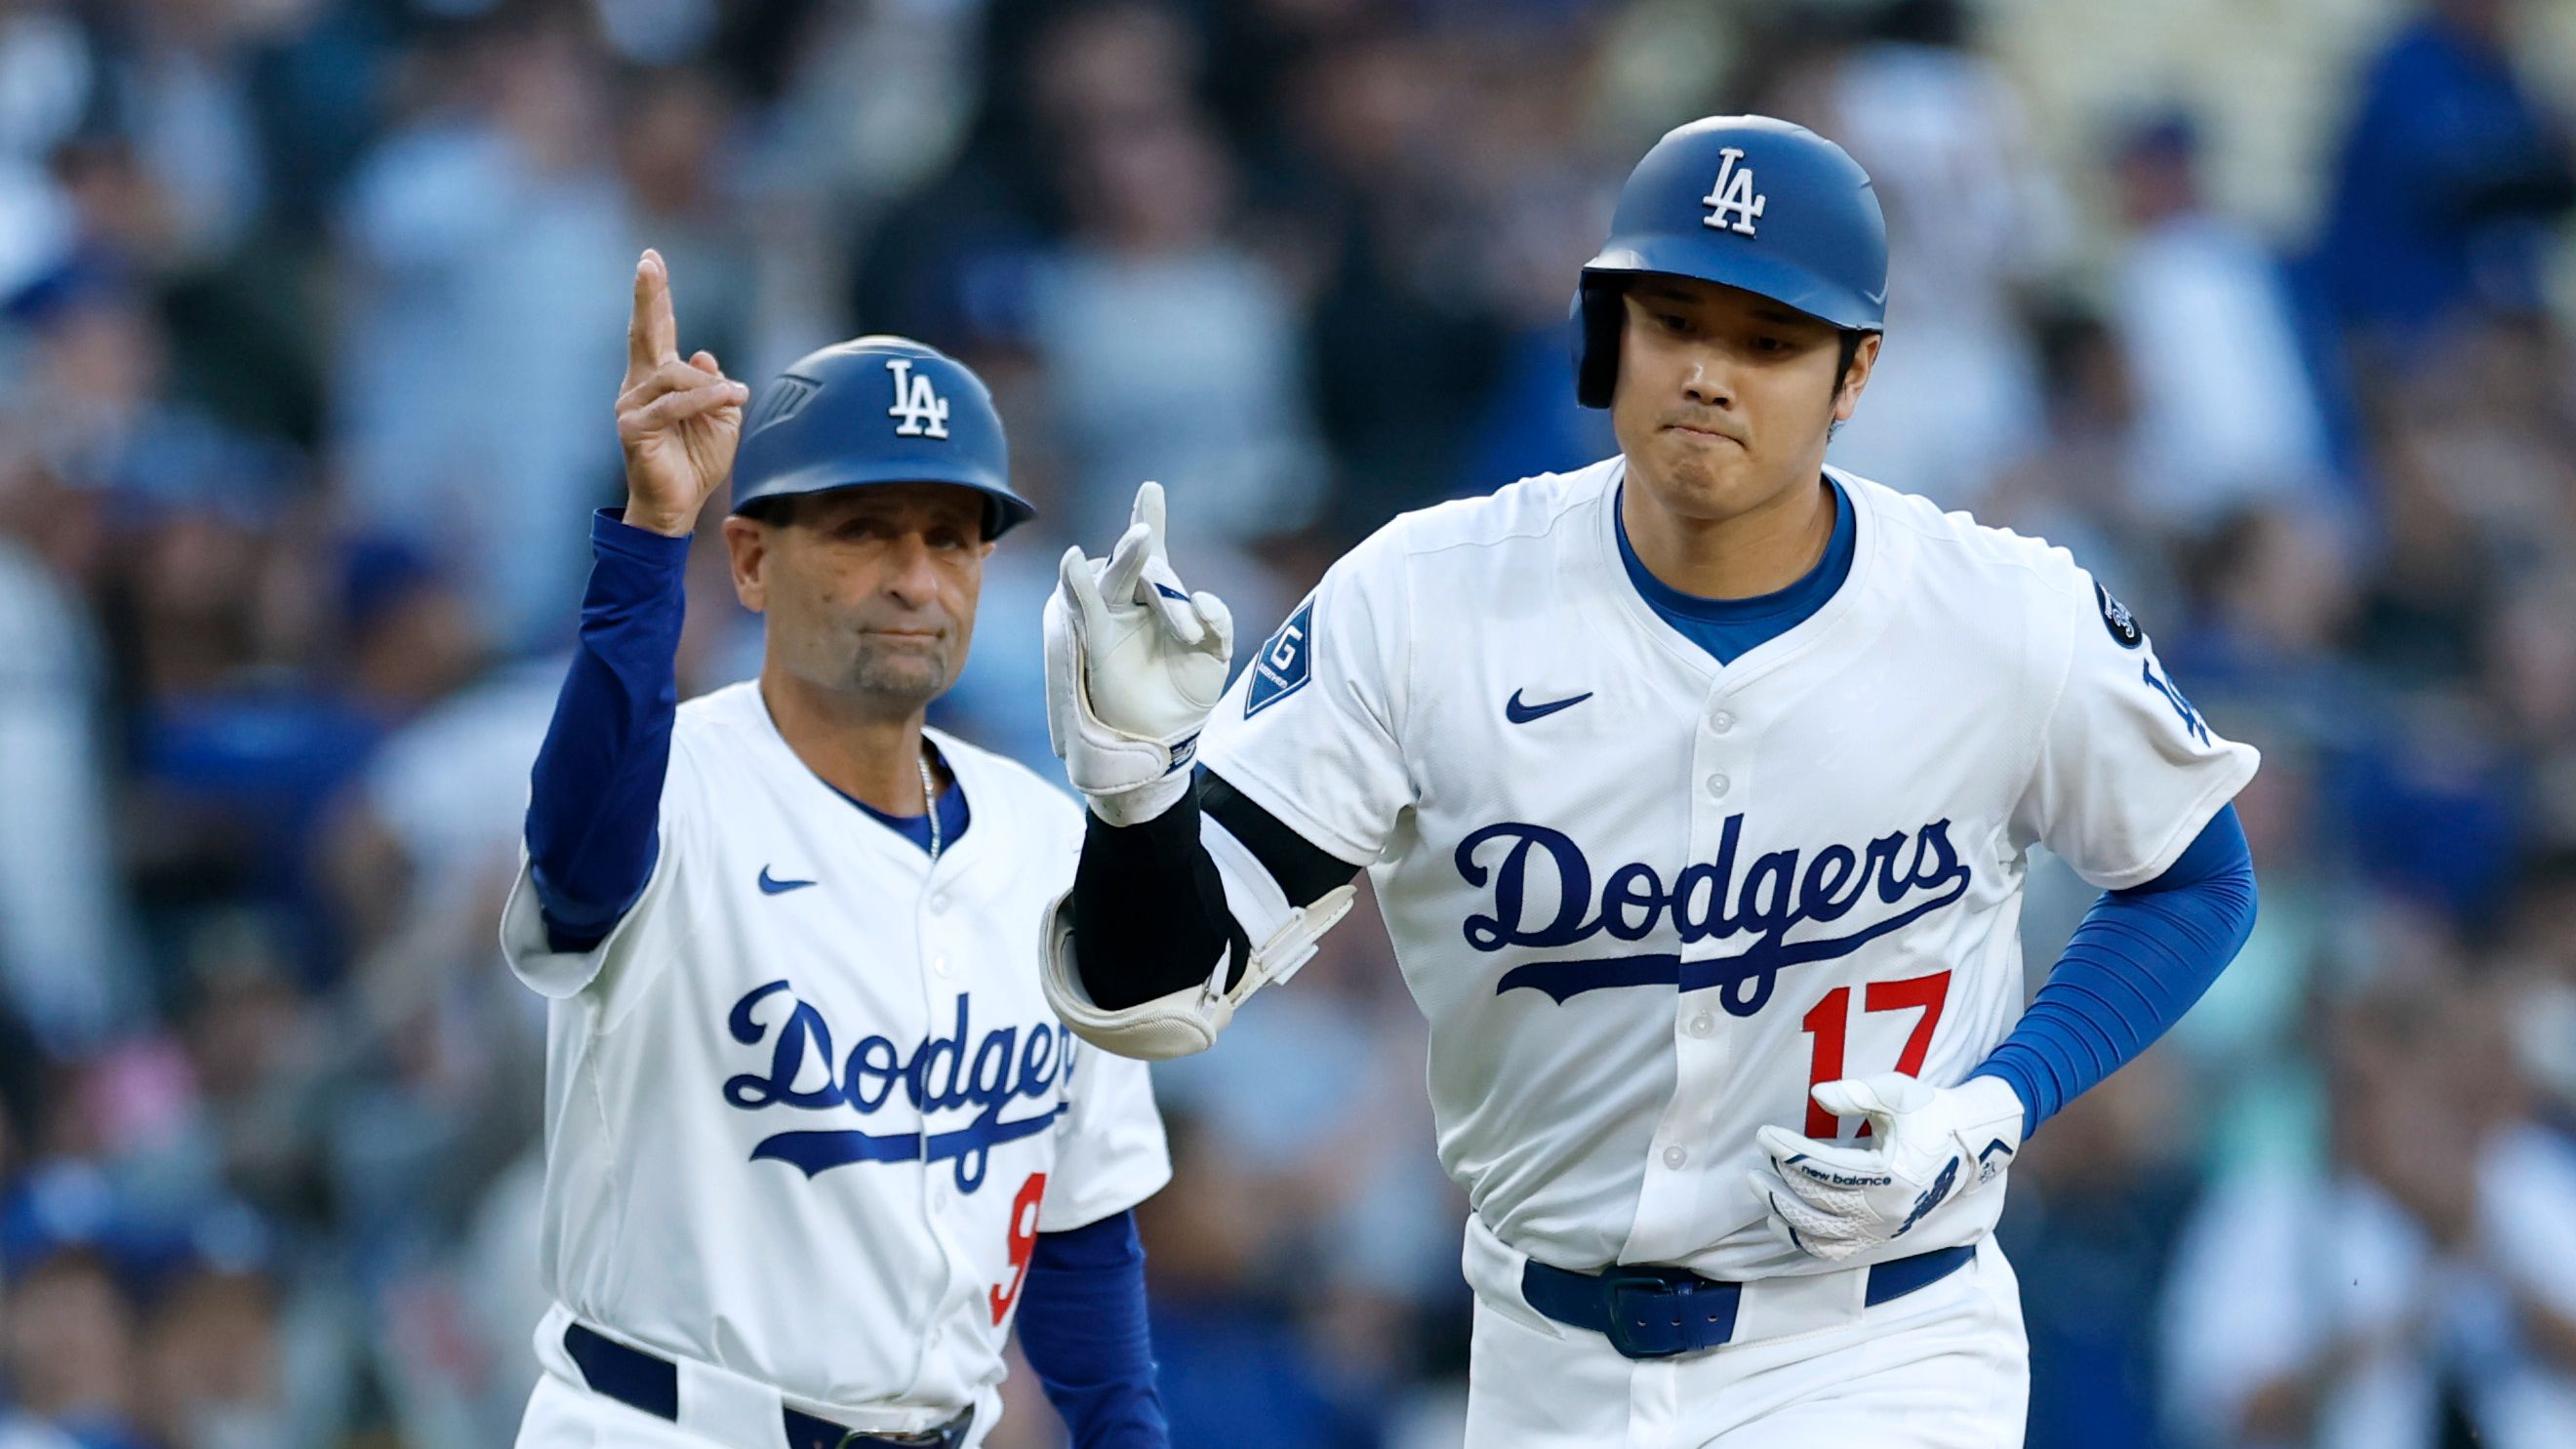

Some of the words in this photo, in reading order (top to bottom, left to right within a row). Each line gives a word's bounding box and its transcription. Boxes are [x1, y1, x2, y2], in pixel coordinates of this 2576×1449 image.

[1703, 148, 1766, 235] LA
[886, 359, 948, 439] LA
[1270, 624, 1303, 671] G
[1455, 813, 1971, 1017] Dodgers
[1802, 969, 1952, 1140] 17
[1801, 1165, 1830, 1181] new
[1832, 1173, 1891, 1187] balance
